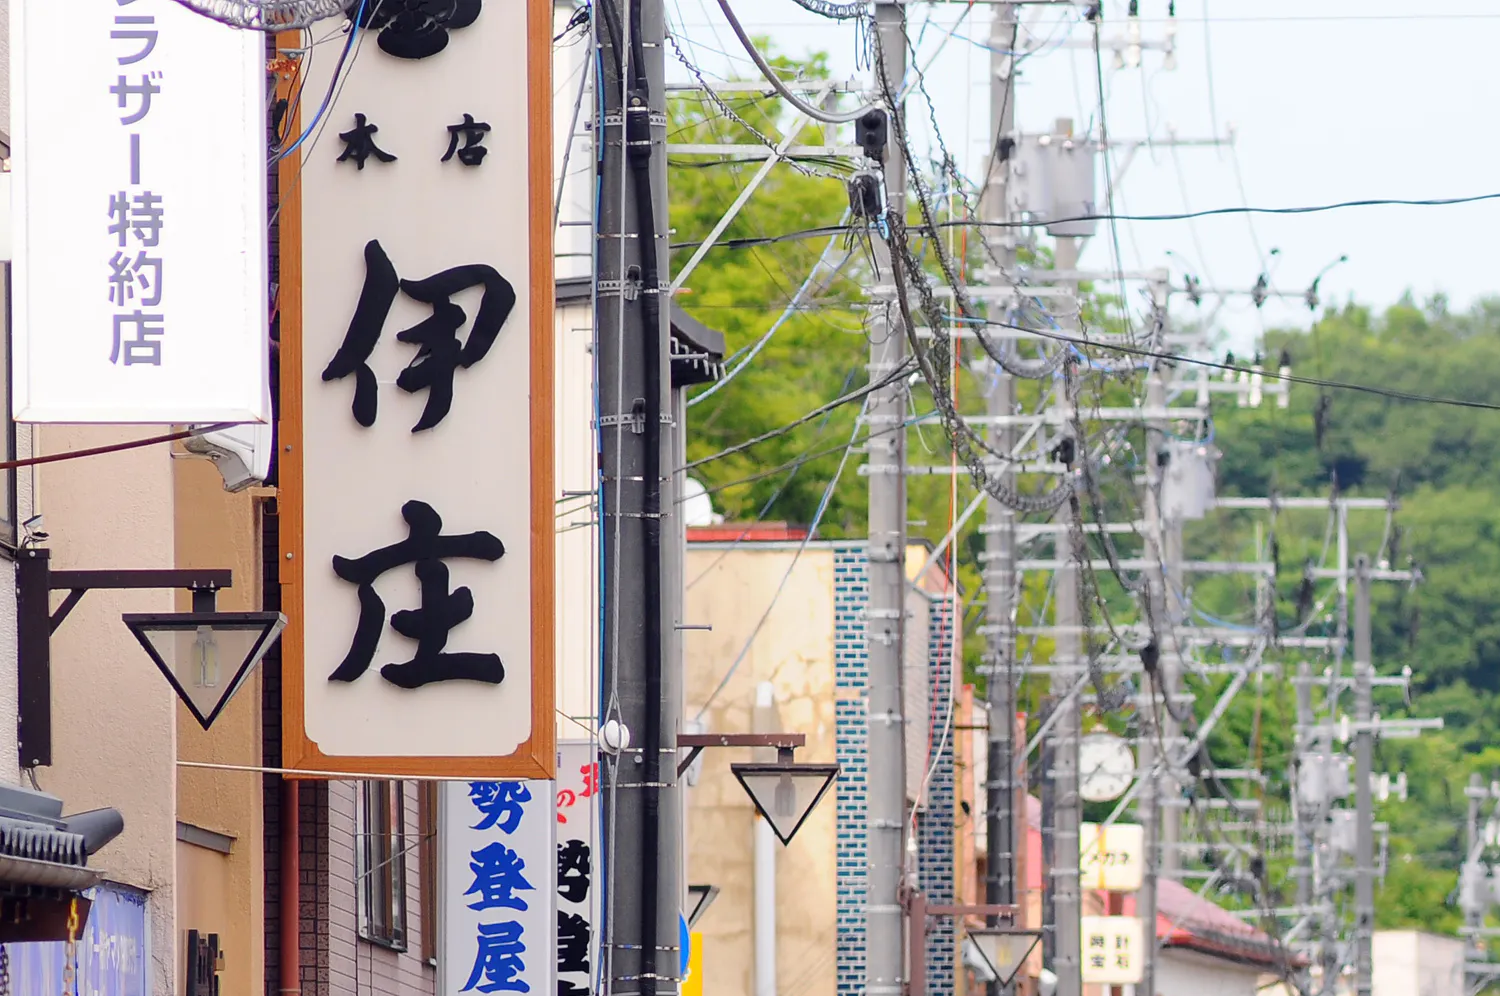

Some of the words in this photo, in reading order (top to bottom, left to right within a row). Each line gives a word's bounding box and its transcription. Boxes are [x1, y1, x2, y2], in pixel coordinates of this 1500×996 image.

[108, 0, 164, 366] ラザー特約店
[337, 113, 493, 170] 本店
[322, 239, 517, 689] 伊庄
